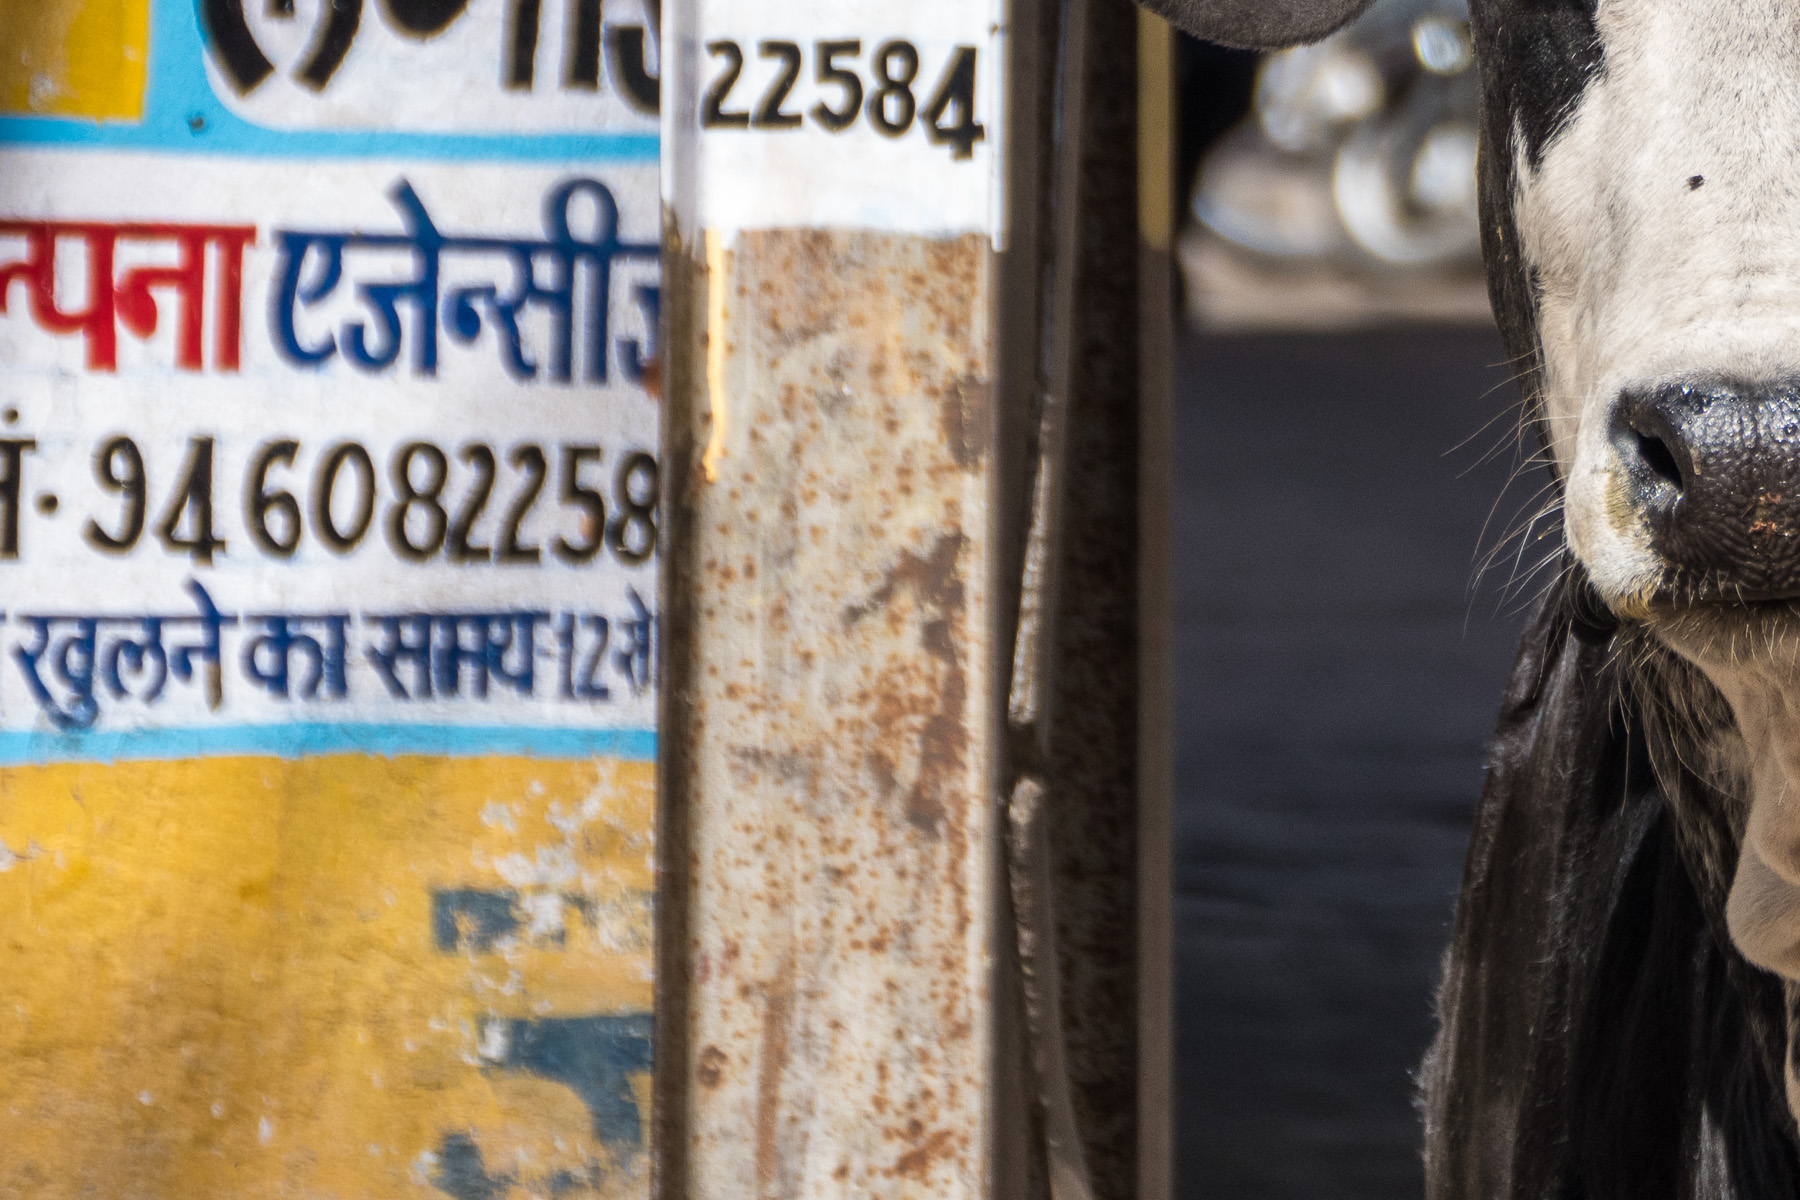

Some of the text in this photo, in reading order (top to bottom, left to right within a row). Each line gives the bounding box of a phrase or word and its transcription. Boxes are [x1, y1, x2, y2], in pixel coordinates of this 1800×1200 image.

[700, 38, 986, 162] 22584
[10, 575, 240, 732] खुलने
[240, 610, 350, 701] का
